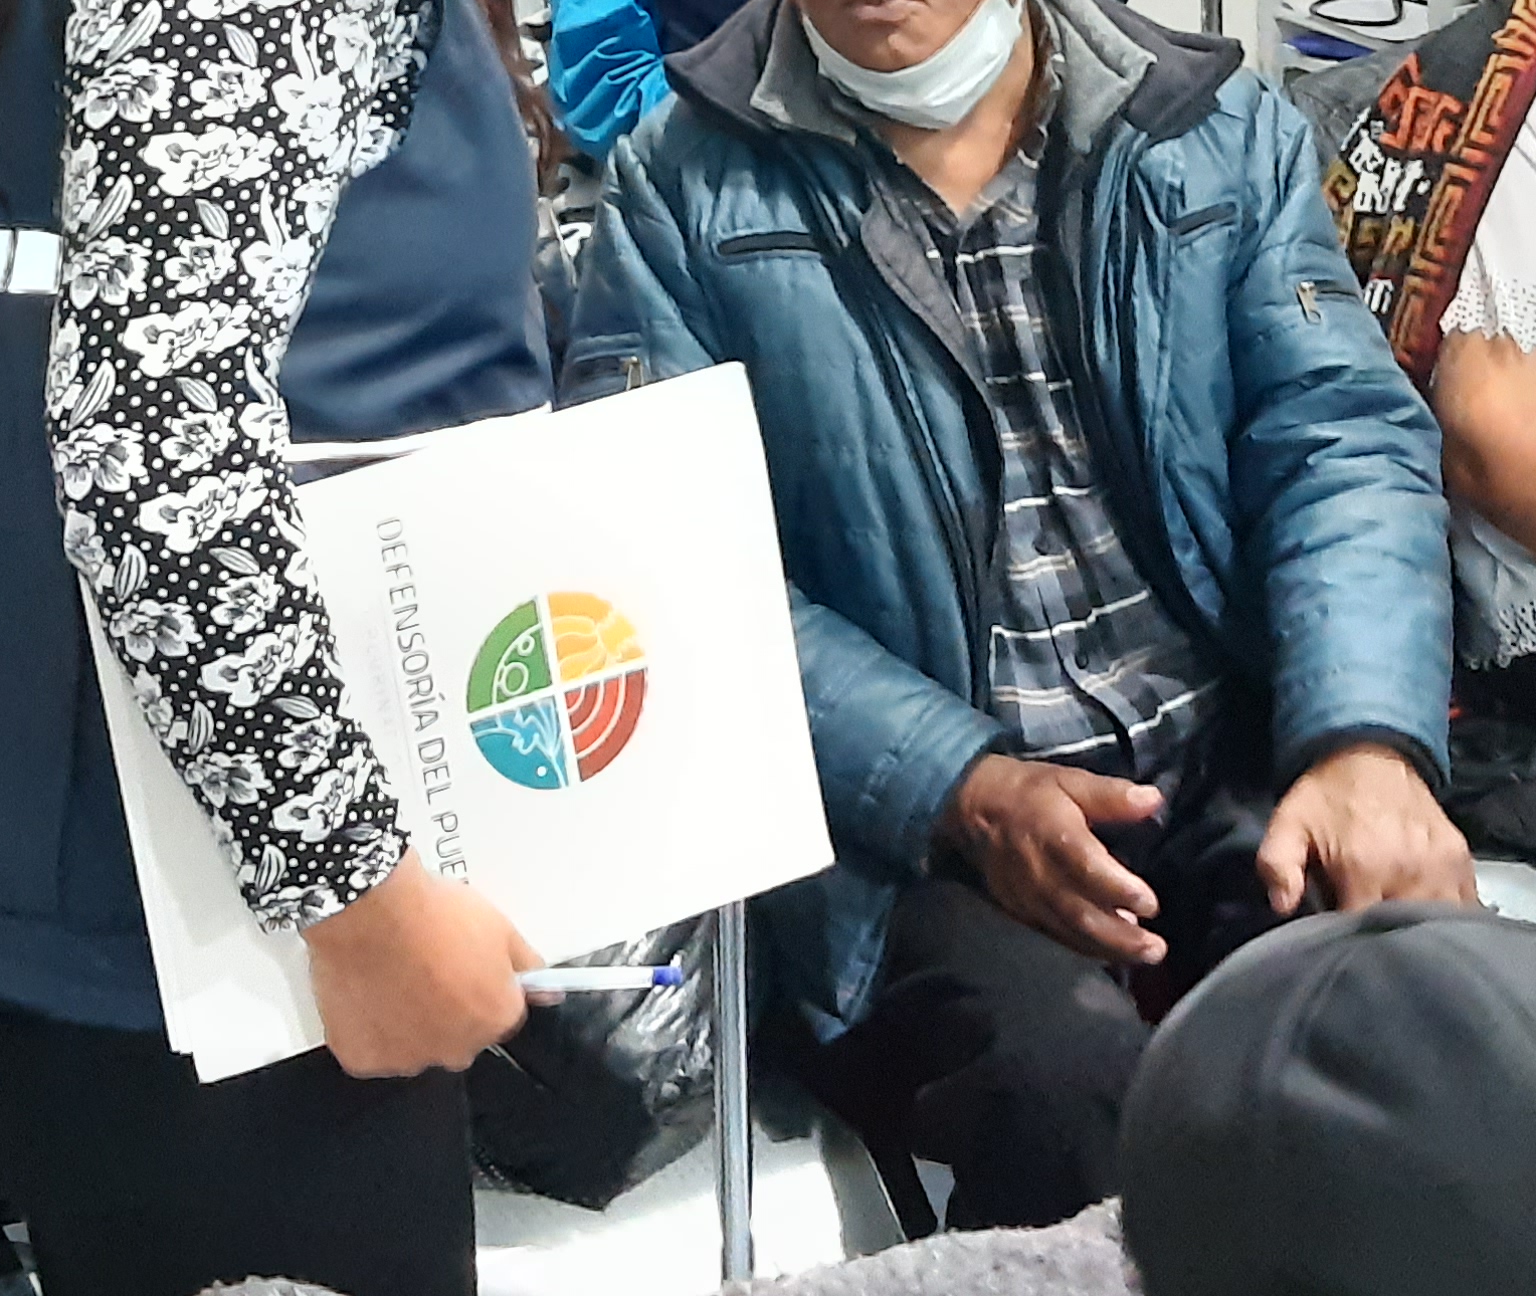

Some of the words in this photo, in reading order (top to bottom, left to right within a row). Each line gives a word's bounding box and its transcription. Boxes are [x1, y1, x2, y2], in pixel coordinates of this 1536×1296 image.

[375, 516, 447, 733] DEFENSORÍA
[417, 736, 453, 806] DEL
[430, 809, 470, 885] PUE
